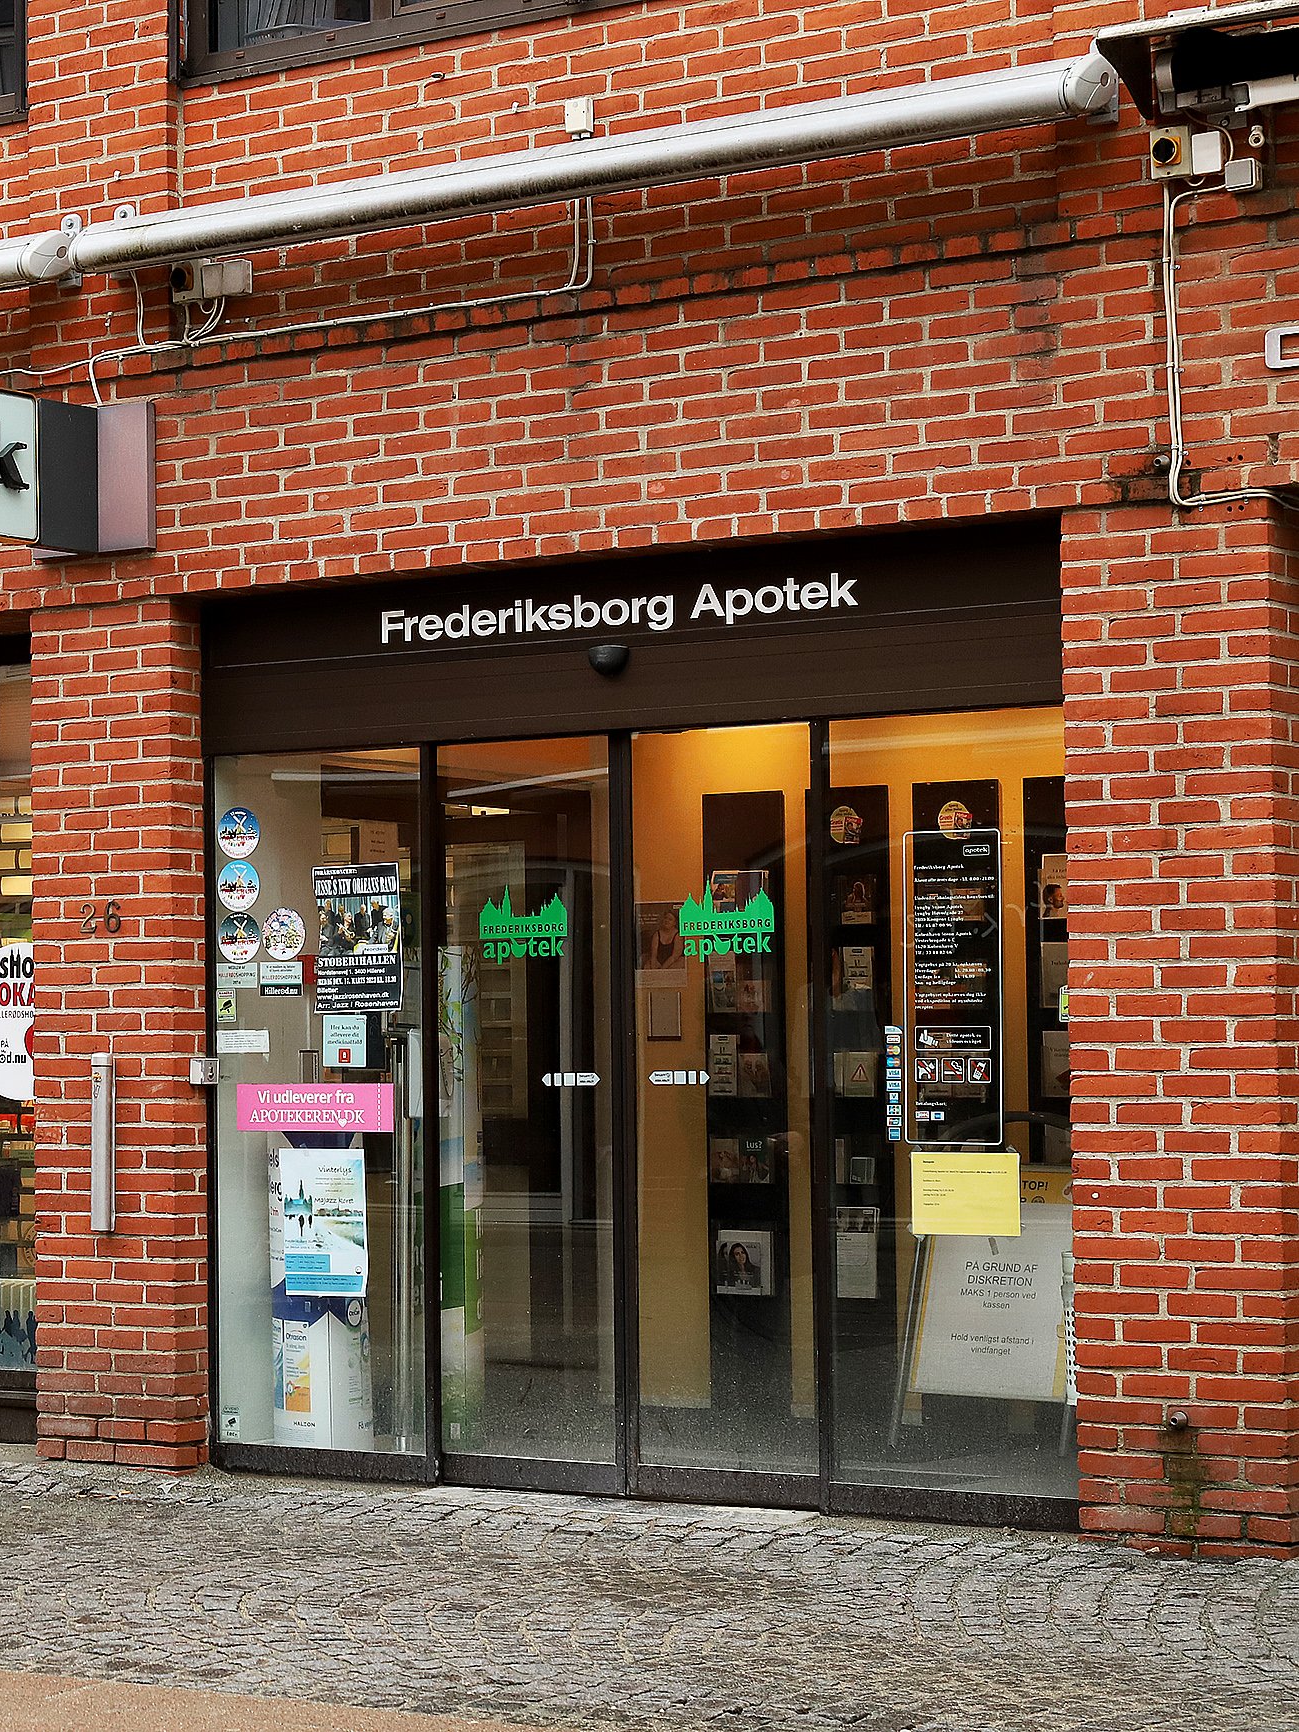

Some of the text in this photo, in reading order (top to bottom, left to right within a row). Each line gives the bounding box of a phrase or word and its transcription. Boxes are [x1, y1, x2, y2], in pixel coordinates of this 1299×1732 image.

[381, 572, 859, 644] Frederiksborg Apotek
[338, 879, 351, 894] NEW
[352, 877, 379, 894] ORLEANS
[380, 876, 396, 892] BAND
[80, 901, 121, 933] 26
[483, 922, 564, 934] FREDERIKSBORG
[684, 919, 771, 930] FREDERIKSBORG
[1, 1038, 9, 1048] PÅ
[257, 1090, 354, 1104] Vi udleverer fra
[746, 1141, 763, 1149] Lus?
[1022, 1181, 1048, 1190] TOP!
[983, 1262, 1021, 1272] GRUND
[1024, 1264, 1038, 1273] AF
[968, 1275, 1032, 1286] DISKRETION
[960, 1288, 984, 1297] MAKS
[993, 1291, 1019, 1299] person
[983, 1301, 1010, 1309] kassen
[951, 1333, 968, 1341] Hold
[970, 1334, 999, 1344] venligst
[1001, 1336, 1029, 1344] afstand
[971, 1346, 1010, 1356] vindfanget
